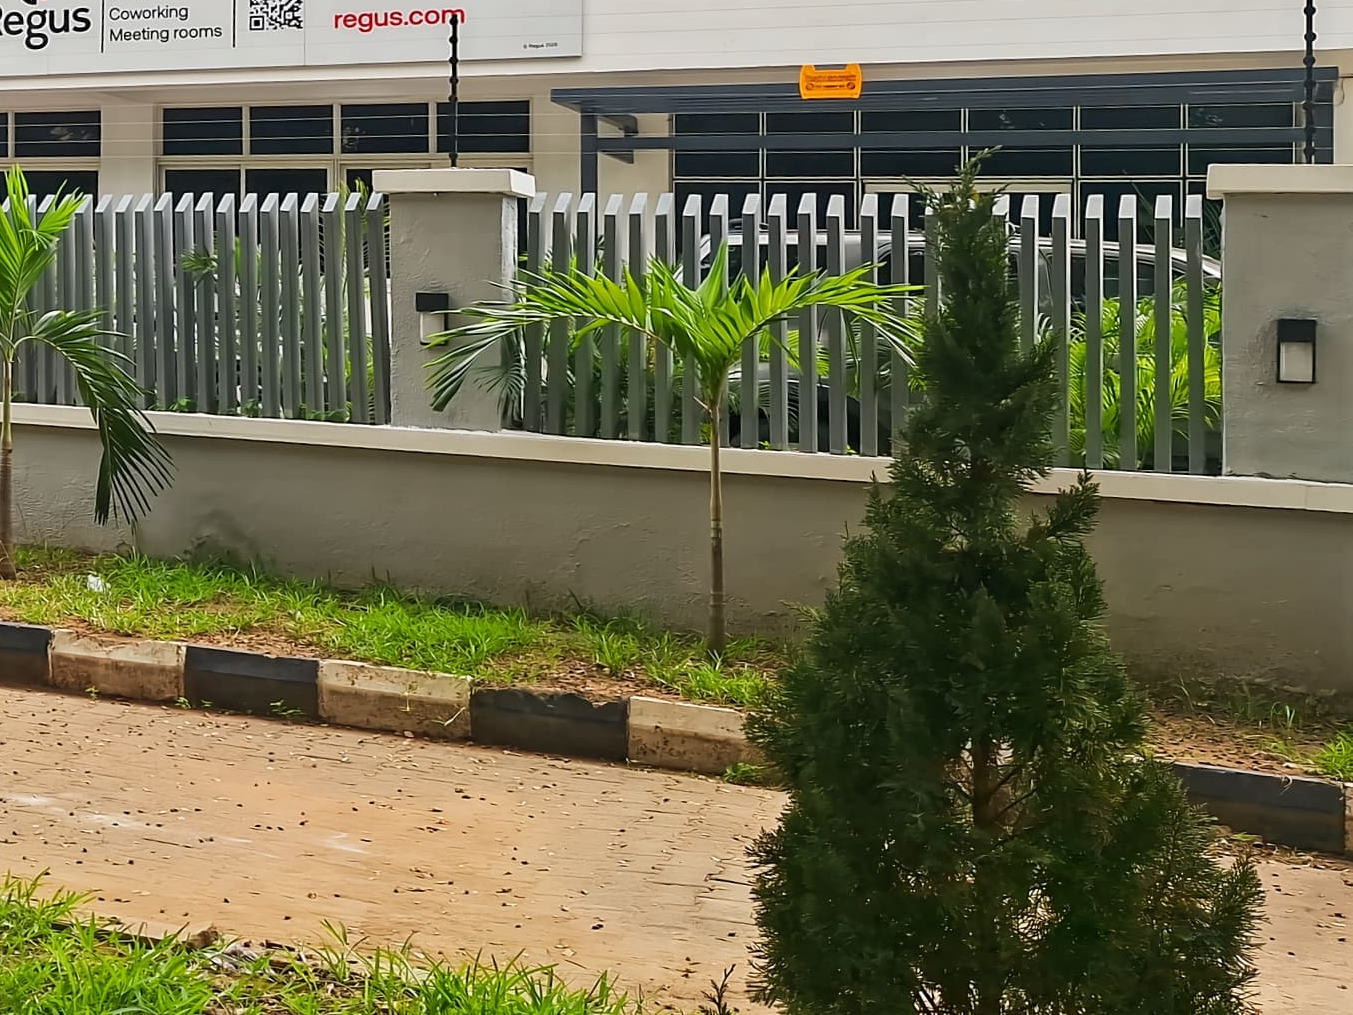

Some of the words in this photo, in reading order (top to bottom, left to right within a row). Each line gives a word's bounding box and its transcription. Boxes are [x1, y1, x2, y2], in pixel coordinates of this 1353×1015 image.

[108, 4, 189, 22] Coworking
[333, 8, 466, 34] regus.com
[109, 26, 170, 44] Meeting
[173, 26, 223, 40] rooms
